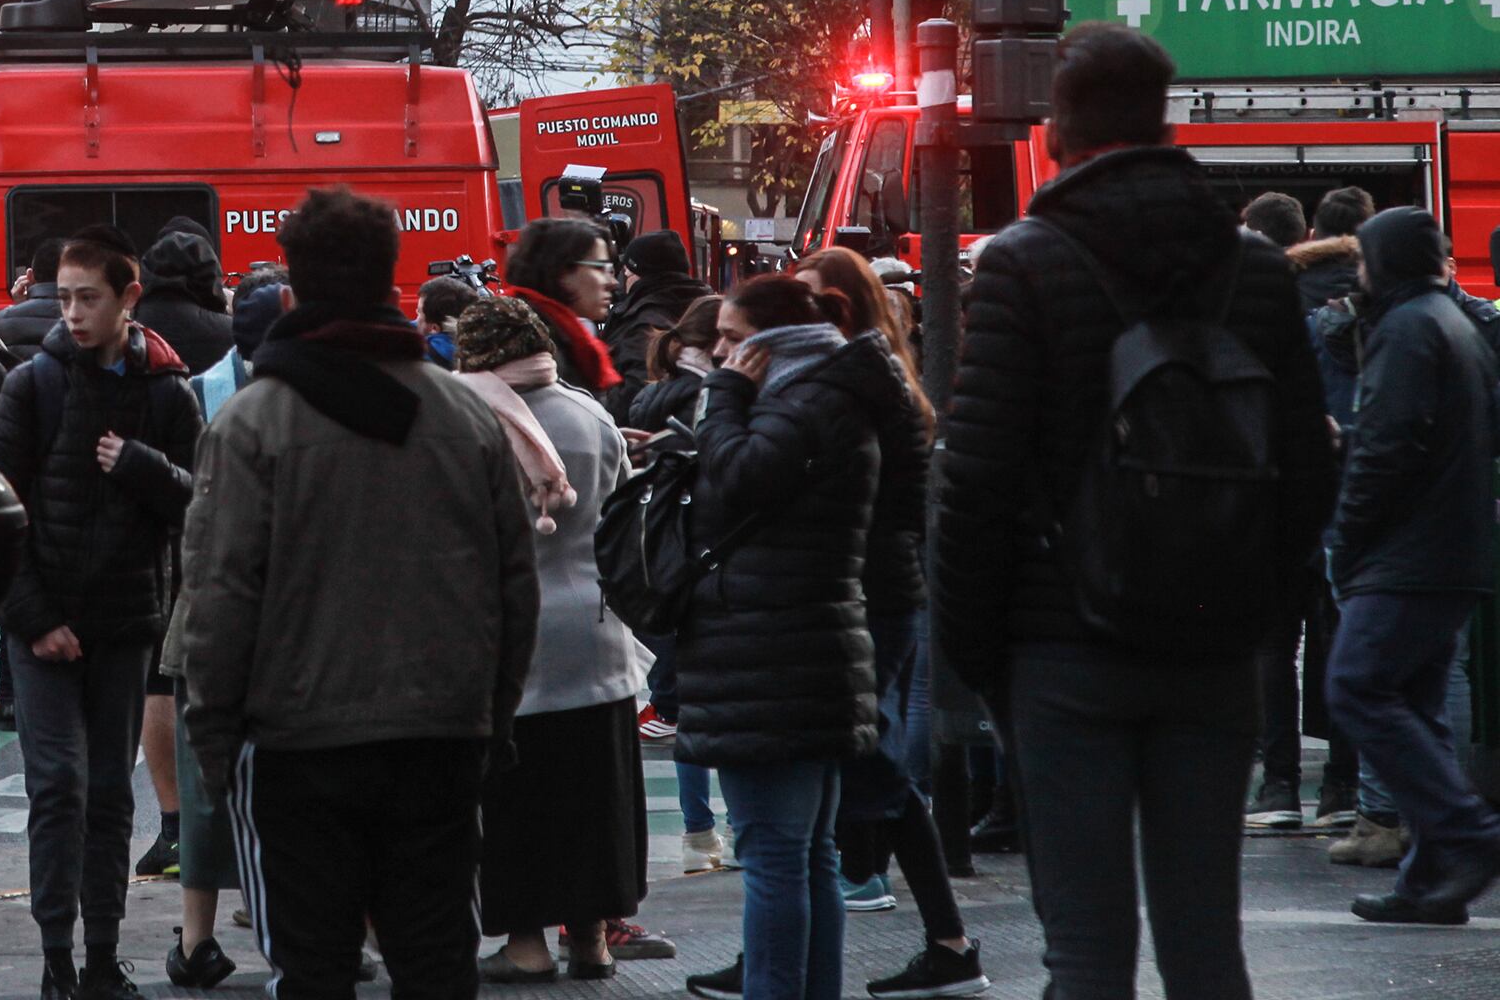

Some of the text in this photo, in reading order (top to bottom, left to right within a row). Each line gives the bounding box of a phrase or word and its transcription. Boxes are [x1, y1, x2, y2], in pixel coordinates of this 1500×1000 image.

[1266, 19, 1361, 47] INDIRA
[537, 112, 658, 135] PUESTO COMANDO
[576, 132, 619, 147] MOVIL
[602, 194, 633, 208] EROS
